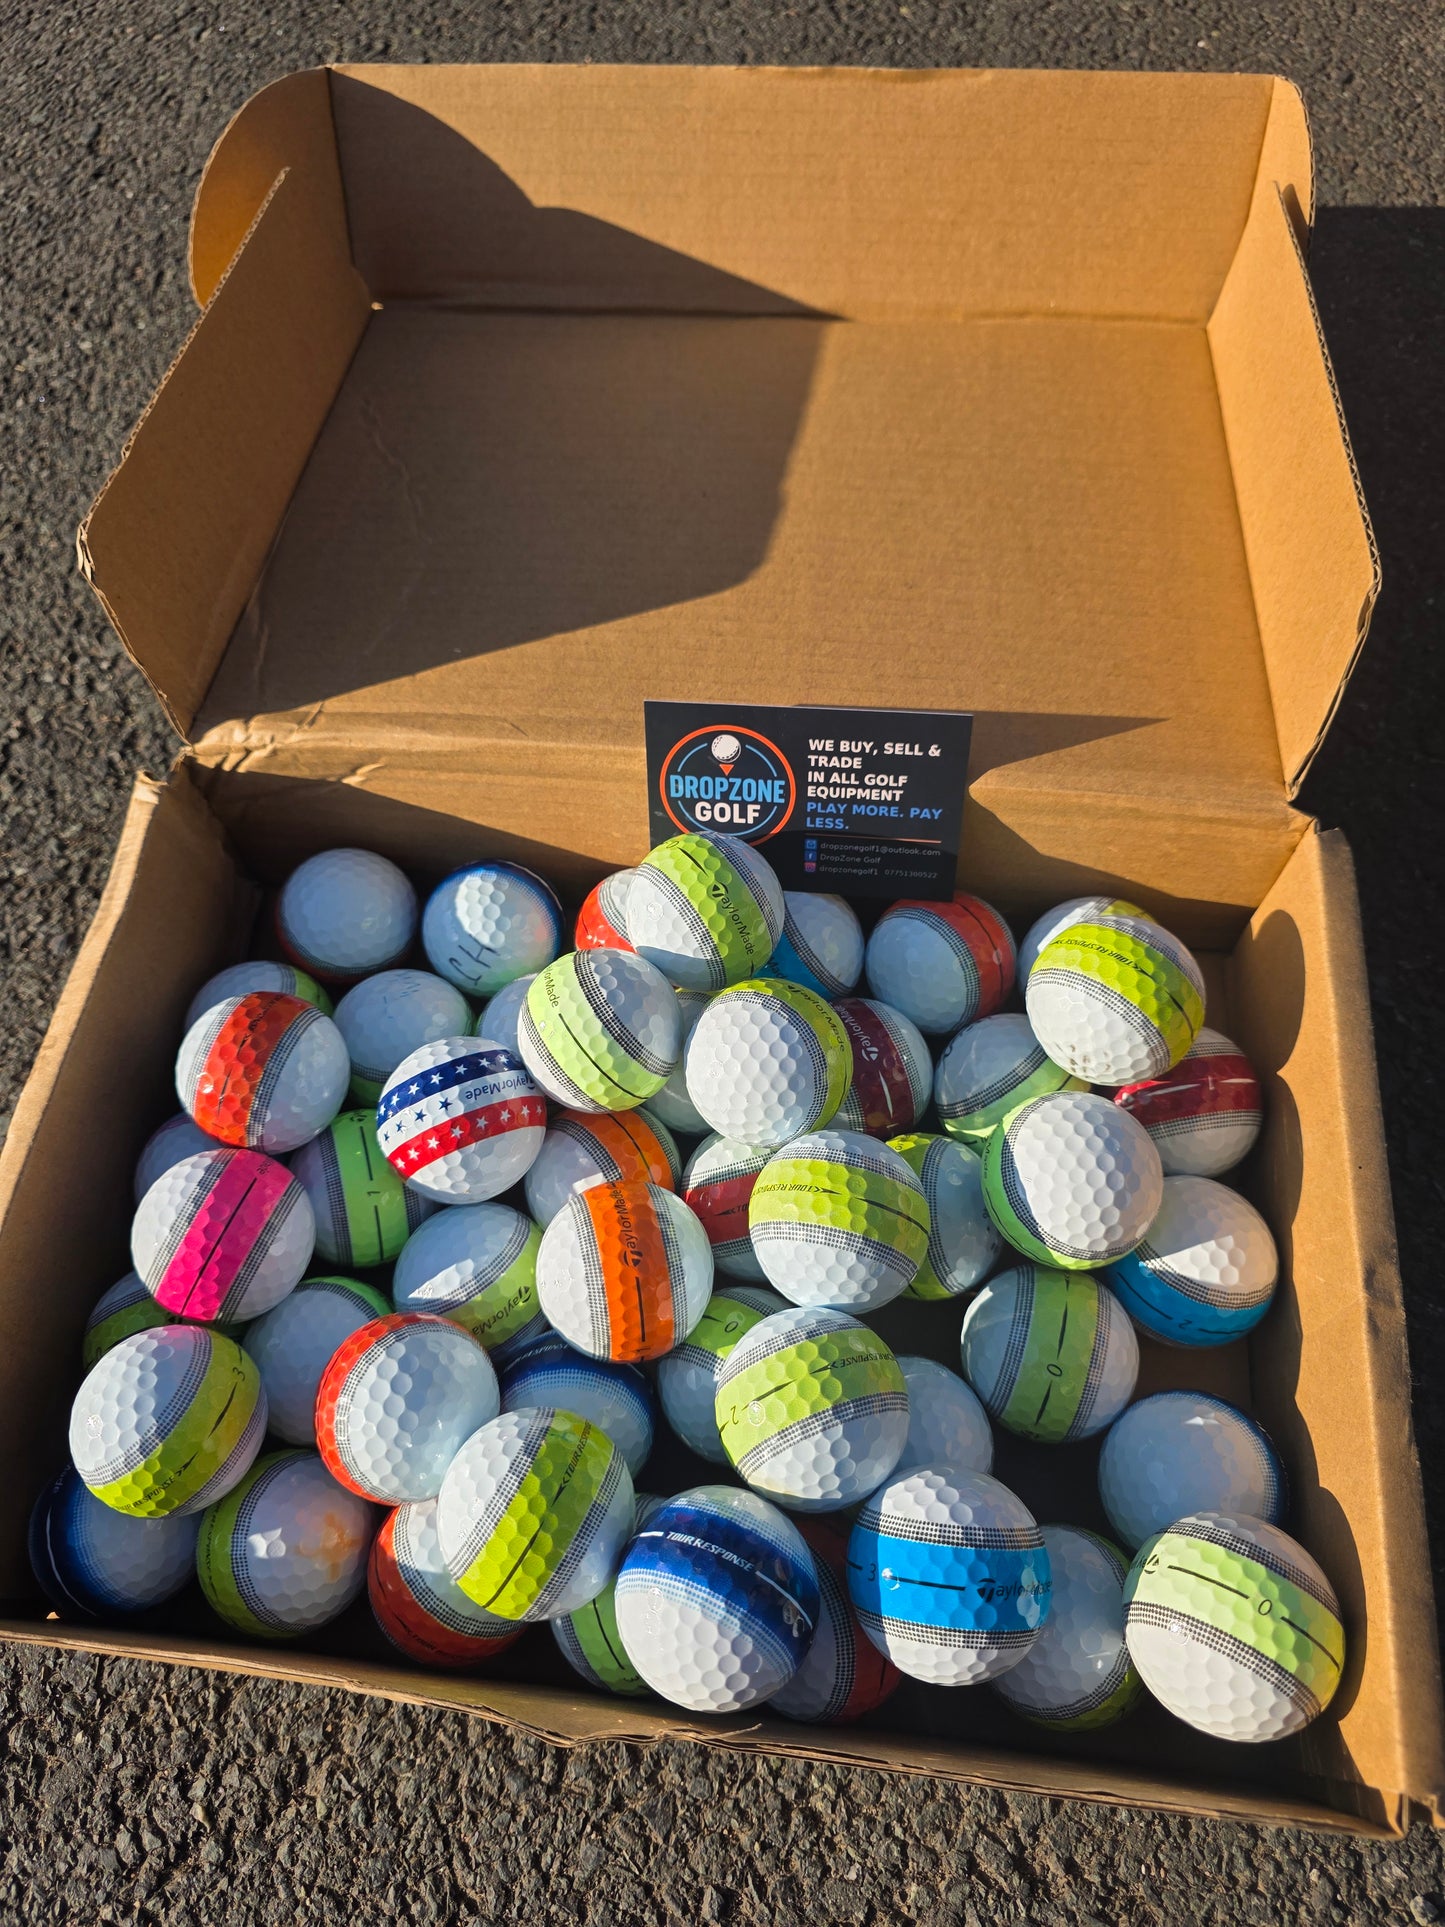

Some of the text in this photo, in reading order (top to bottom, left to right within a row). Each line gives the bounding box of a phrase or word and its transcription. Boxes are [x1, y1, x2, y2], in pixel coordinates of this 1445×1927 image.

[809, 738, 942, 758] WE BUY, SELL &
[807, 754, 863, 770] TRADE
[669, 774, 786, 804] DROPZONE
[807, 771, 909, 788] IN ALL GOLF
[807, 785, 905, 802] EQUIPMENT
[694, 801, 761, 825] GOLF
[806, 801, 943, 820] PLAY MORE. PAY
[805, 817, 850, 830] LESS.
[819, 842, 941, 857] dropzonegolf1@outlook.com
[819, 853, 881, 865] DropZone Golf
[819, 865, 879, 877] dropzonegolf1
[711, 881, 755, 956] TaylorMade
[612, 1188, 644, 1268] TaylorMade
[471, 1285, 532, 1337] TaylorMa
[665, 1531, 755, 1572] TOUR RESPONSE
[867, 1562, 878, 1582] 3
[1257, 1598, 1273, 1616] 0
